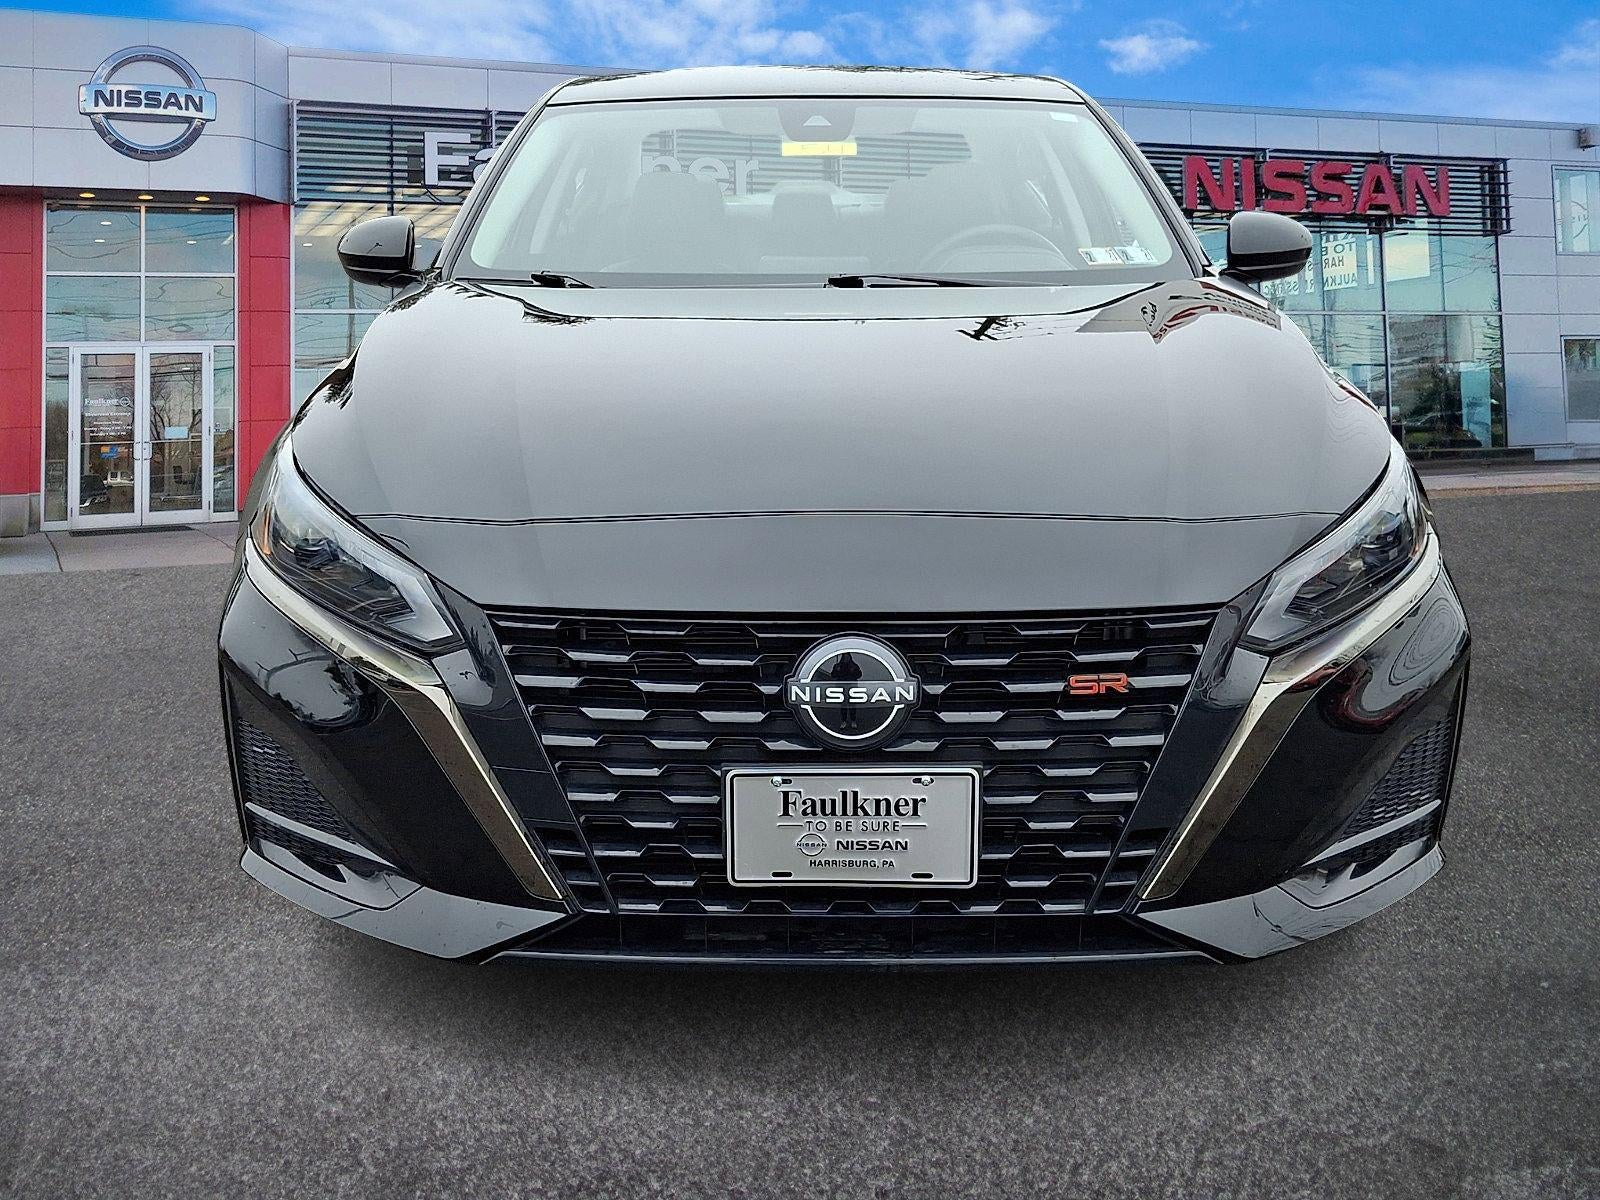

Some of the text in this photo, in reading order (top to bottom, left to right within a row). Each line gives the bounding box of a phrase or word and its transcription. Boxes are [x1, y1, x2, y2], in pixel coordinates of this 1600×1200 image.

[94, 89, 204, 113] NISSAN
[1183, 155, 1451, 217] NISSAN
[791, 685, 914, 703] NISSAN
[1069, 673, 1129, 695] SR
[778, 790, 927, 817] Faulkner
[806, 820, 900, 832] TO BE SURE
[836, 840, 909, 851] NISSAN
[809, 859, 895, 869] HARRISBURG, PA
